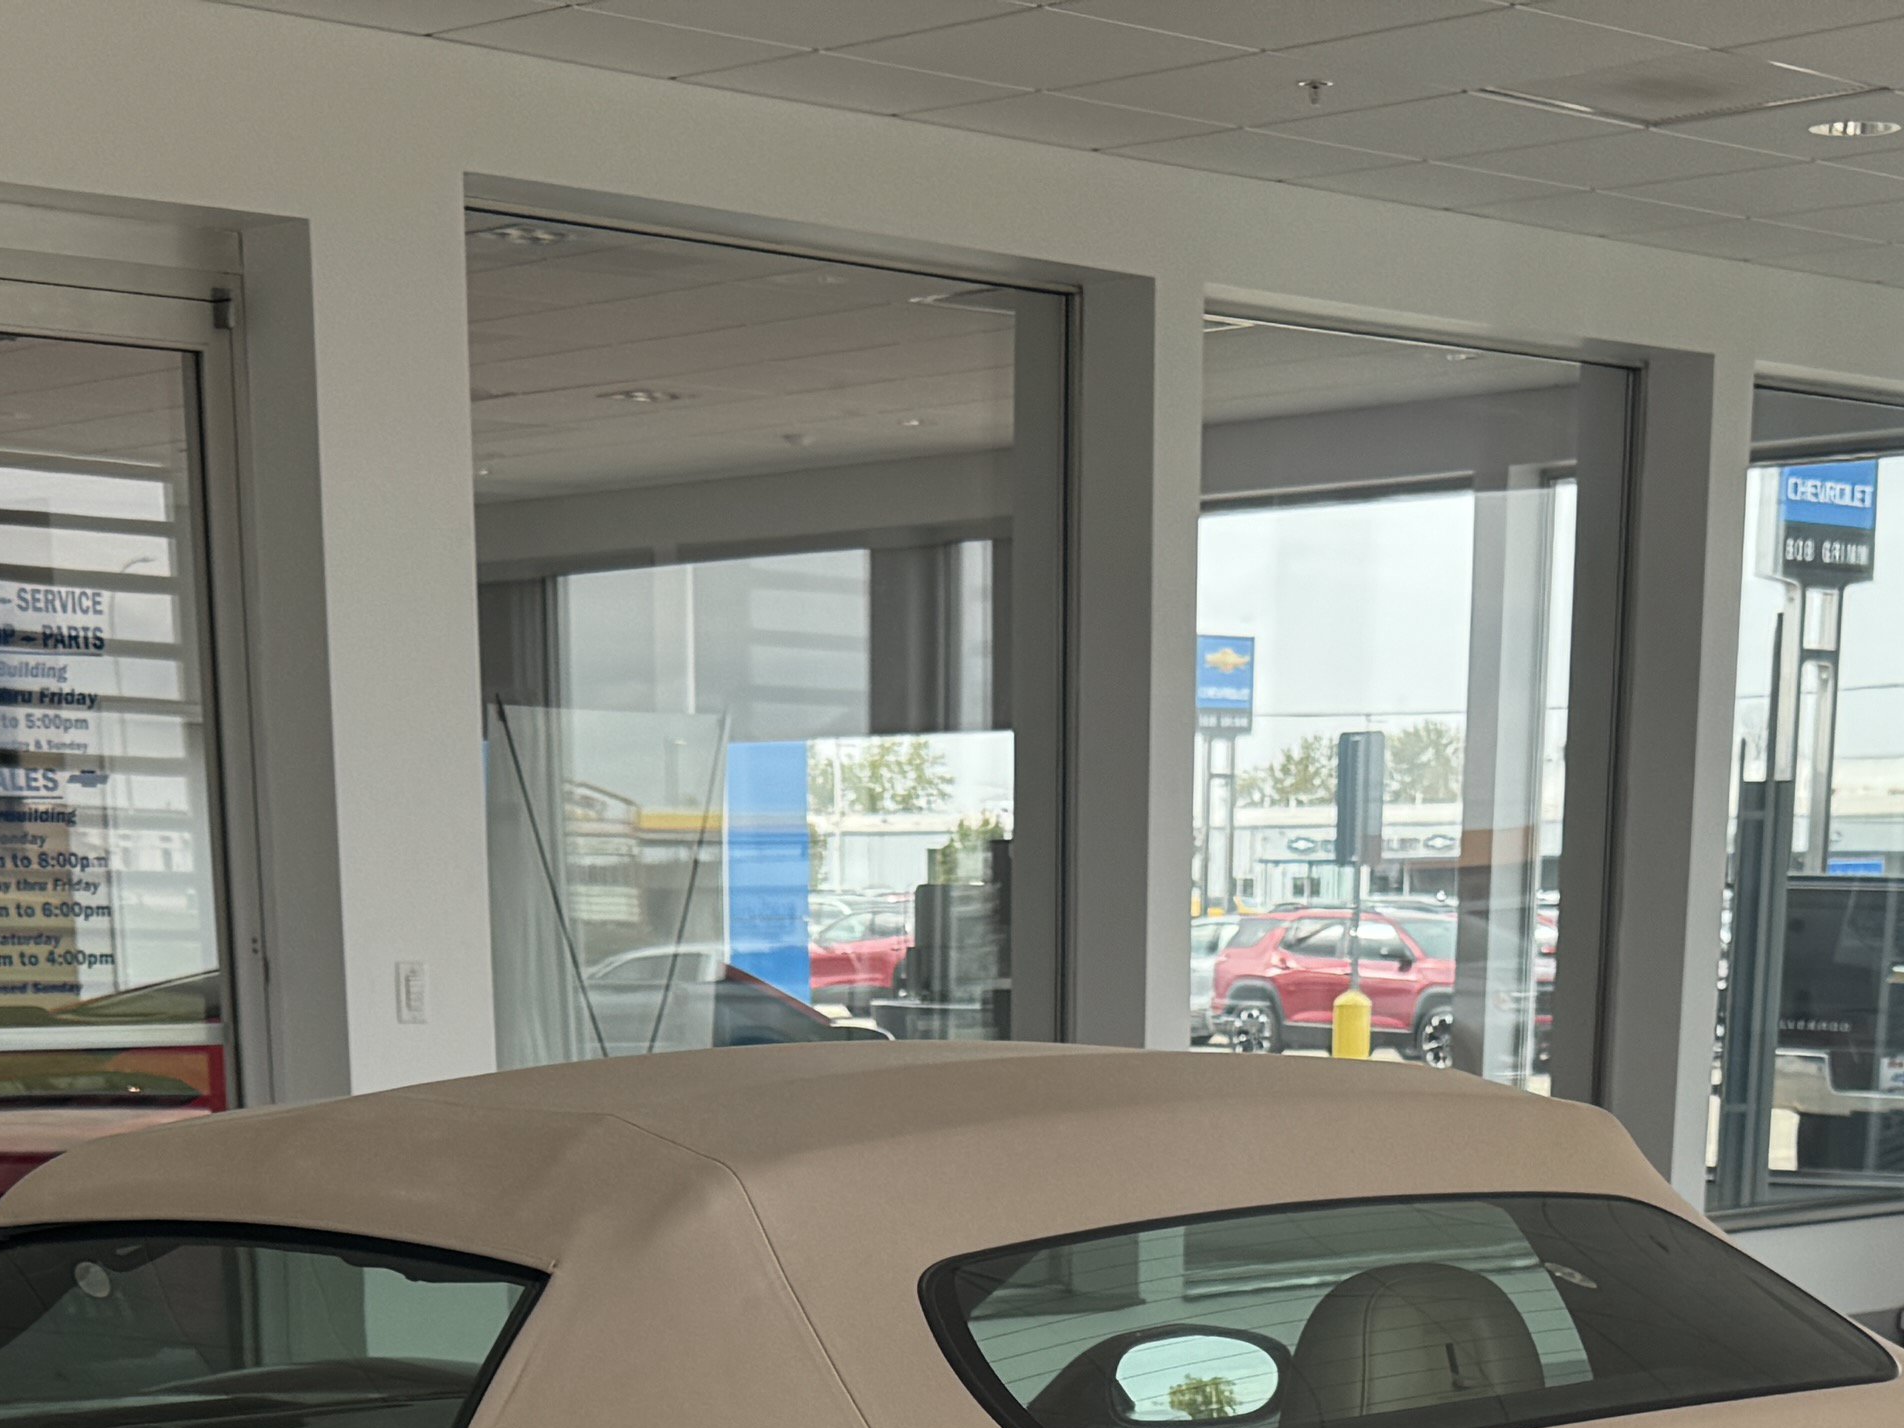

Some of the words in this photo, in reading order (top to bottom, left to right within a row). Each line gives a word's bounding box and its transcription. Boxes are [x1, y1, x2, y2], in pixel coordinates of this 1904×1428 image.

[1786, 477, 1874, 508] CHEVROLET
[1785, 538, 1815, 561] BOB
[1822, 540, 1870, 565] GRIMM
[16, 587, 104, 615] SERVICE
[42, 624, 105, 650] PARTS
[39, 686, 100, 710] Friday
[0, 711, 19, 729] to
[25, 713, 89, 733] 5:00pm
[11, 852, 32, 868] to
[16, 878, 47, 892] thru
[53, 878, 101, 895] Friday
[16, 902, 36, 918] to
[42, 902, 112, 921] 6:00pm
[19, 951, 39, 967] to
[45, 950, 115, 968] 4:00pm
[32, 982, 83, 997] Sunday
